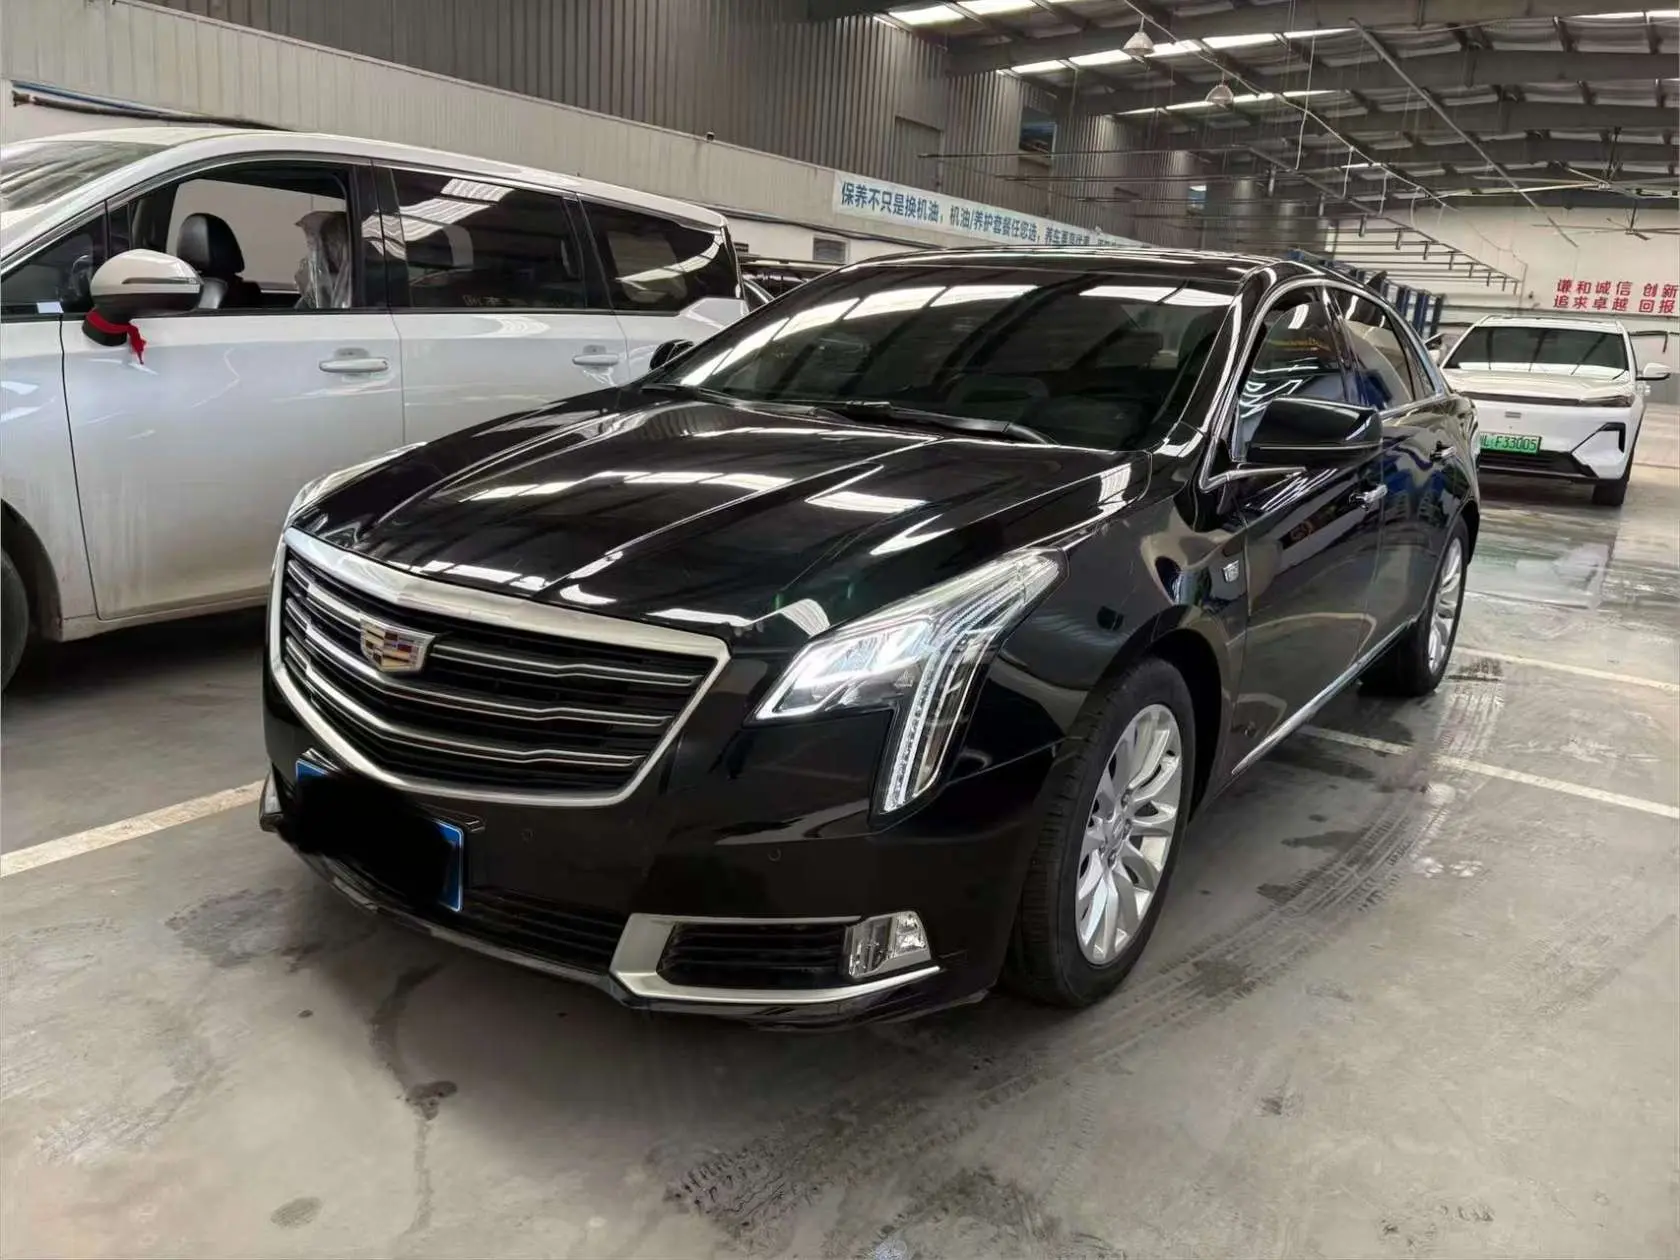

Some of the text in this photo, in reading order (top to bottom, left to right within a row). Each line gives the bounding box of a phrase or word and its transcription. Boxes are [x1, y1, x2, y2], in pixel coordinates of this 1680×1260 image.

[1557, 279, 1678, 298] 谦和诚信 创新
[1553, 295, 1676, 313] 追求卓越 回报
